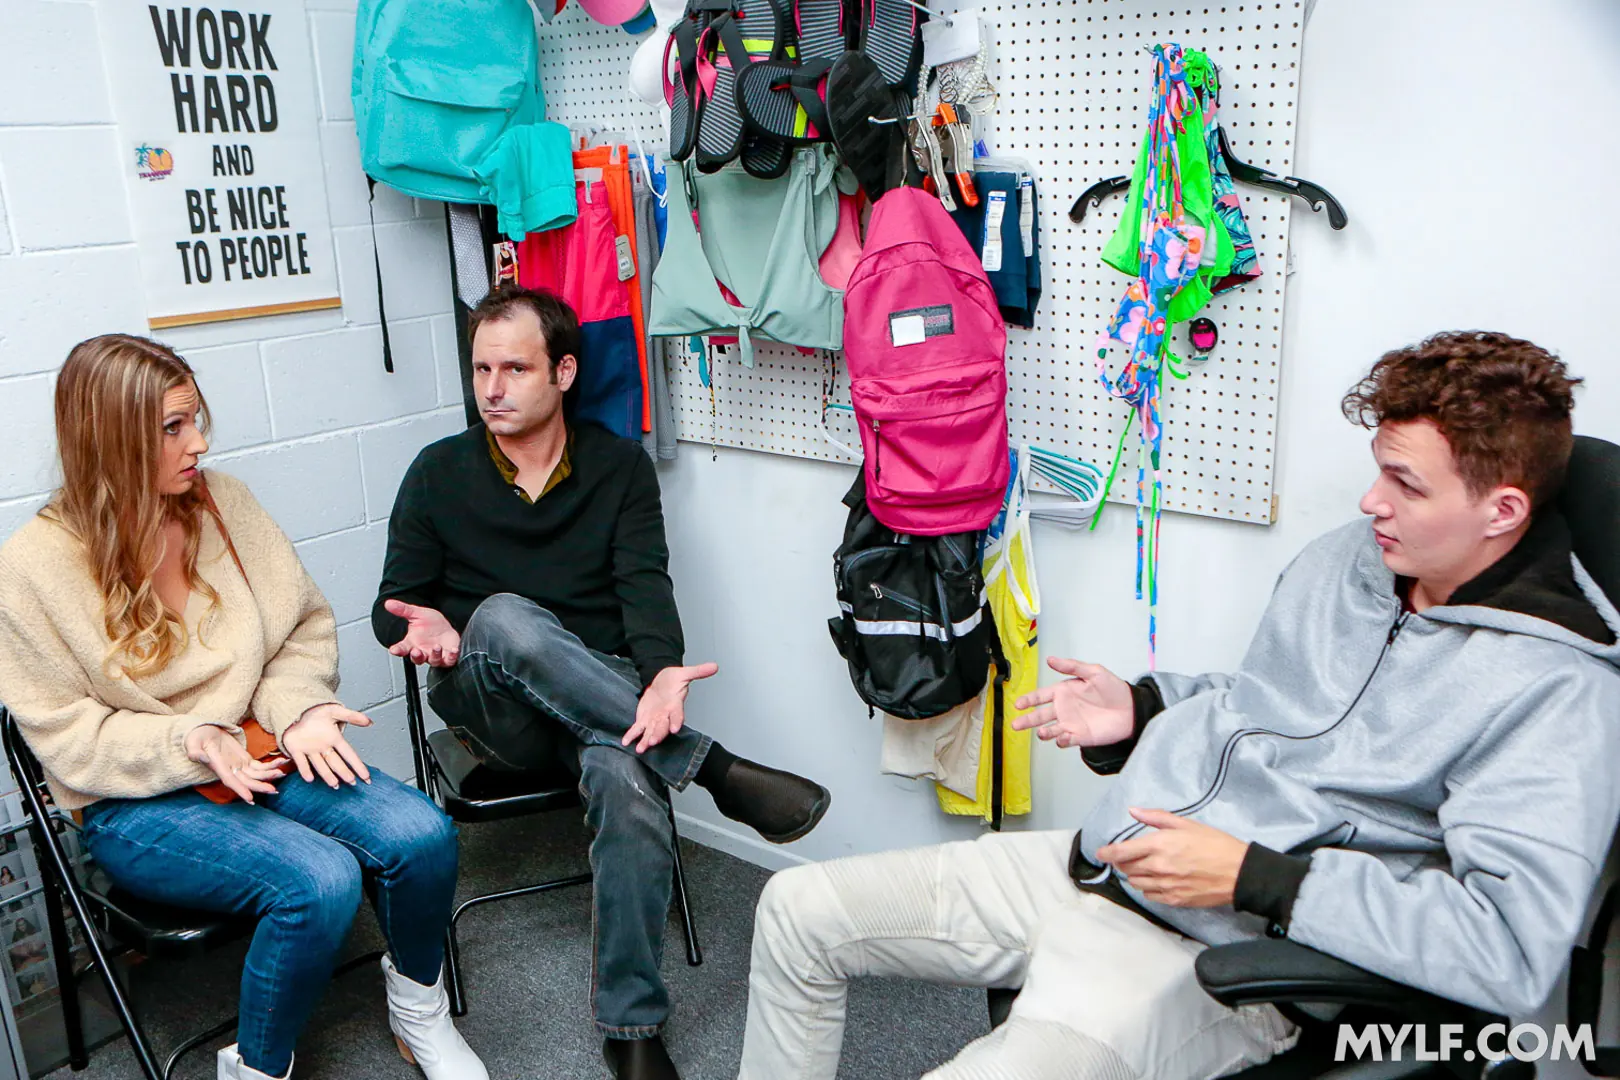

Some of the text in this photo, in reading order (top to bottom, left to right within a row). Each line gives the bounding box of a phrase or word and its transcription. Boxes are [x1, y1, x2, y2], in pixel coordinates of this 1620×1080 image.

[149, 5, 278, 70] WORK
[171, 73, 278, 133] HARD
[213, 145, 254, 176] AND
[185, 186, 289, 234] BE NICE
[176, 233, 310, 284] TO PEOPLE
